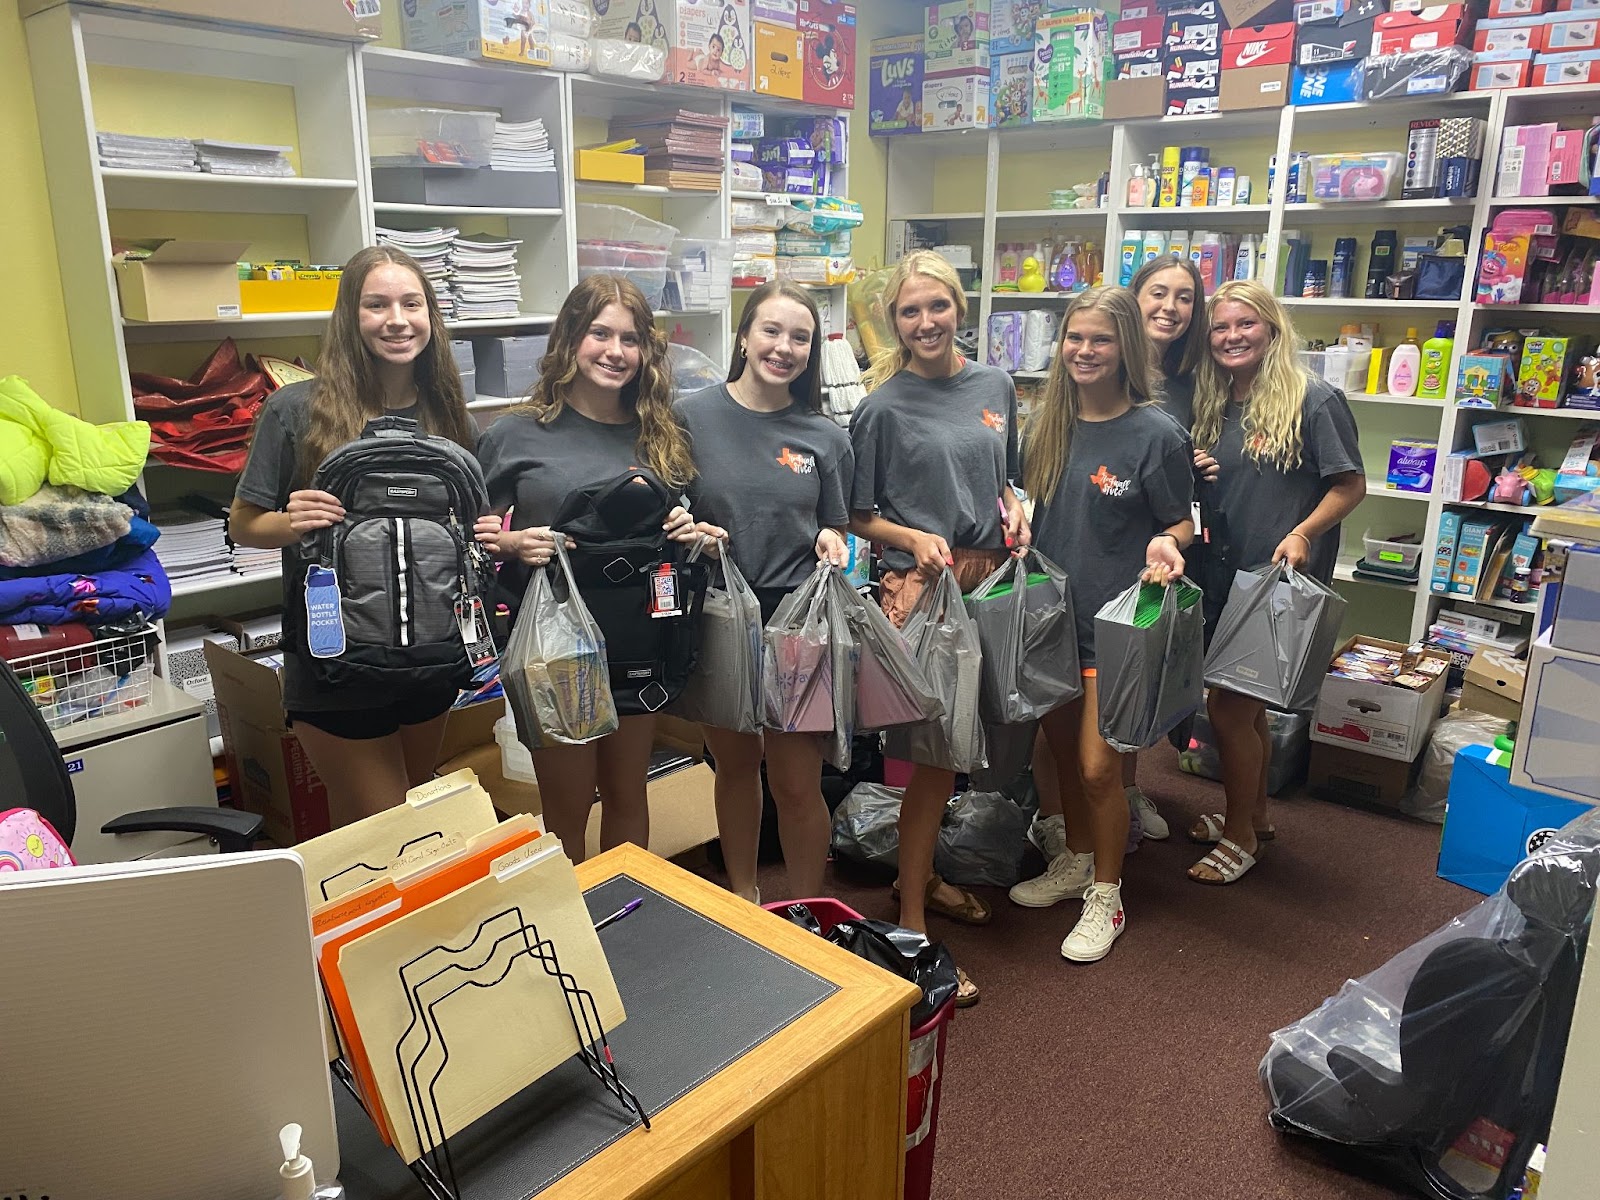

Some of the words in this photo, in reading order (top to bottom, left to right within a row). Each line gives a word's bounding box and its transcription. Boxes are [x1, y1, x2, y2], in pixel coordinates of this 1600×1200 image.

[1244, 41, 1268, 56] NIKE
[679, 71, 686, 83] 2
[881, 58, 915, 88] Luvs
[1411, 120, 1440, 129] REVLON
[1446, 166, 1454, 190] CONAIR
[1397, 456, 1428, 468] always
[1446, 518, 1453, 527] 4
[1463, 527, 1485, 535] GIANT
[310, 603, 335, 611] WATER
[311, 610, 337, 619] BOTTLE
[311, 619, 338, 627] POCKET
[186, 677, 207, 686] Oxford
[67, 761, 82, 772] 21
[415, 783, 452, 801] Donations
[498, 856, 521, 871] Goods
[524, 842, 543, 858] Used
